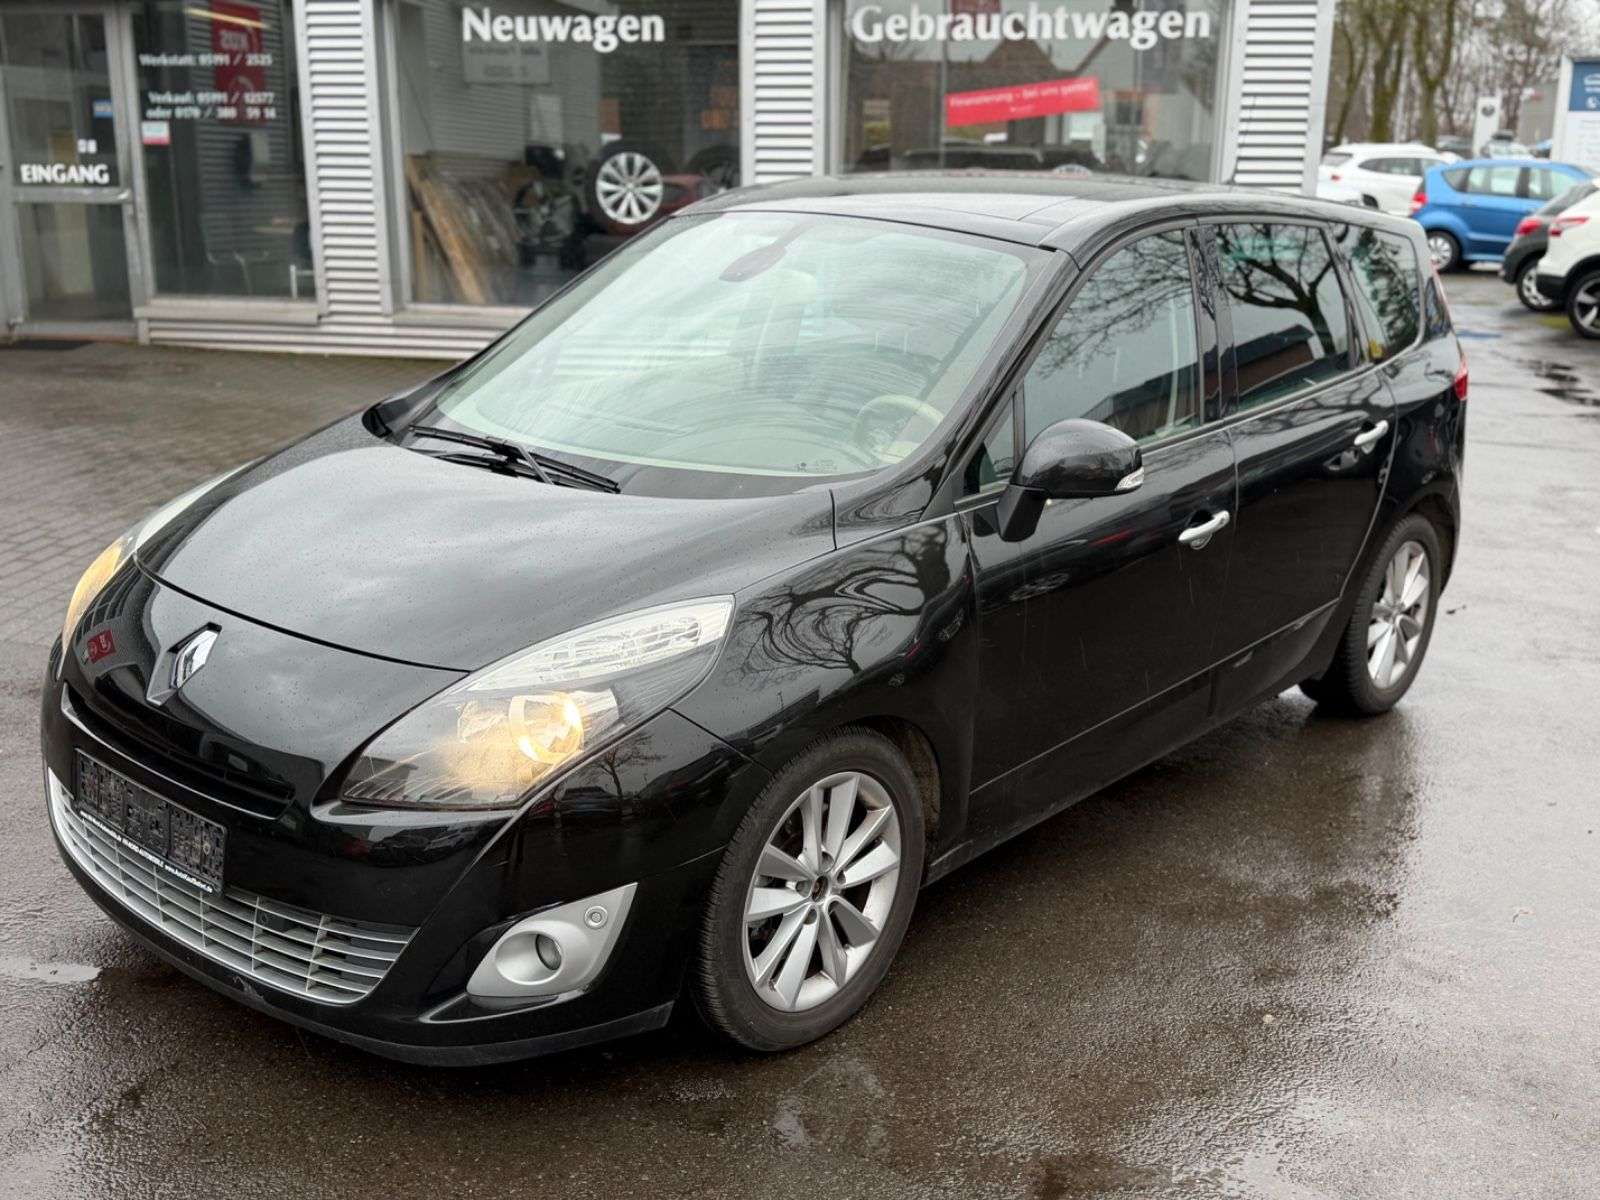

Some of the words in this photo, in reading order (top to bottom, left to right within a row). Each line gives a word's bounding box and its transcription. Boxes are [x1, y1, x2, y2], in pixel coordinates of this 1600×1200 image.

[462, 8, 665, 53] Neuwagen
[851, 3, 1211, 50] Gebrauchtwagen
[20, 164, 110, 184] EINGANG
